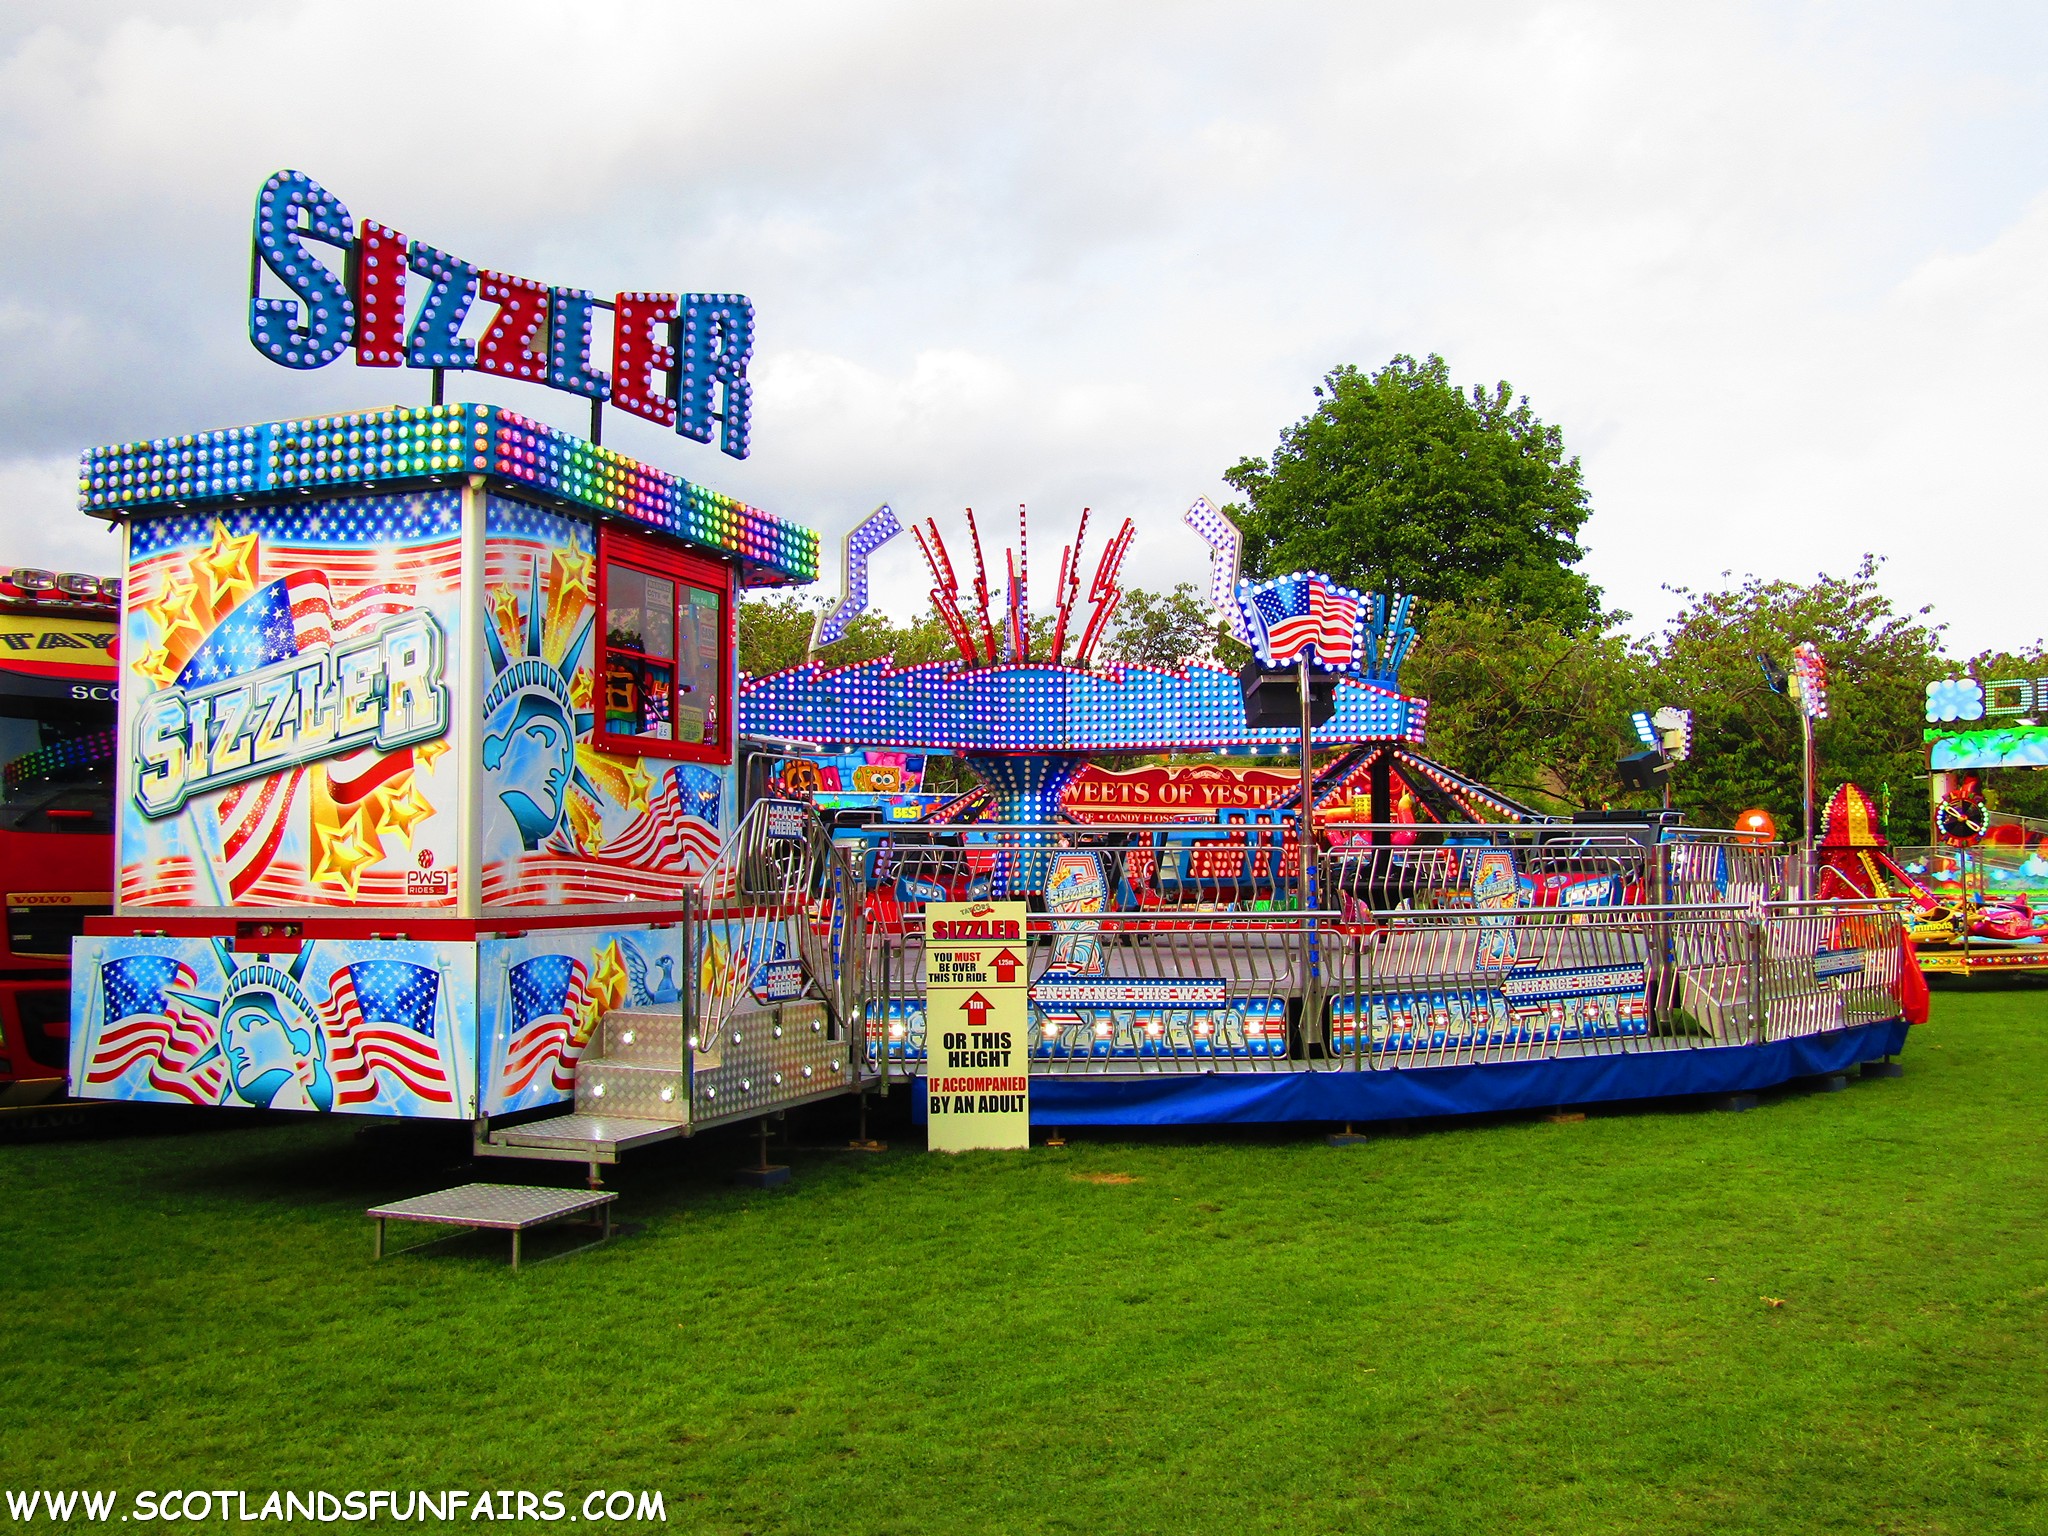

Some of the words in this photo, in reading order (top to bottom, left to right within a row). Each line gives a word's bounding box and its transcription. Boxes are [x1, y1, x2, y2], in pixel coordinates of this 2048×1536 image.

[249, 168, 756, 461] SIZZLER
[0, 632, 117, 650] TAY
[136, 616, 445, 815] SIZZLER
[1063, 781, 1150, 804] WEETS
[1158, 783, 1195, 804] OF
[776, 804, 797, 819] PAY
[893, 805, 922, 819] BEST
[1107, 813, 1143, 822] CANDY
[1144, 814, 1175, 822] FLOSS
[775, 821, 797, 835] HERE
[408, 871, 444, 884] PWS
[13, 896, 72, 904] VOLVO
[932, 920, 1020, 939] SIZZLER
[934, 952, 952, 962] YOU
[954, 952, 981, 962] MUST
[775, 965, 796, 980] PAY
[939, 963, 951, 972] BE
[953, 963, 976, 972] OVER
[928, 973, 951, 982] THIS
[952, 973, 964, 982] TO
[966, 973, 987, 982] RIDE
[1505, 977, 1574, 994] ENTRANCE
[1576, 974, 1605, 988] THIS
[1607, 971, 1642, 986] WAY
[774, 981, 796, 996] HERE
[1035, 987, 1126, 1000] ENTRANCE
[1131, 987, 1171, 1000] THIS
[1175, 987, 1222, 1000] WAY
[968, 1000, 984, 1009] 1m
[943, 1032, 967, 1049] OR
[971, 1032, 1012, 1049] THIS
[948, 1051, 1011, 1068] HEIGHT
[929, 1078, 940, 1092] IF
[942, 1077, 1026, 1092] ACCOMPANIED
[930, 1096, 950, 1114] BY
[954, 1095, 974, 1114] AN
[978, 1094, 1026, 1113] ADULT
